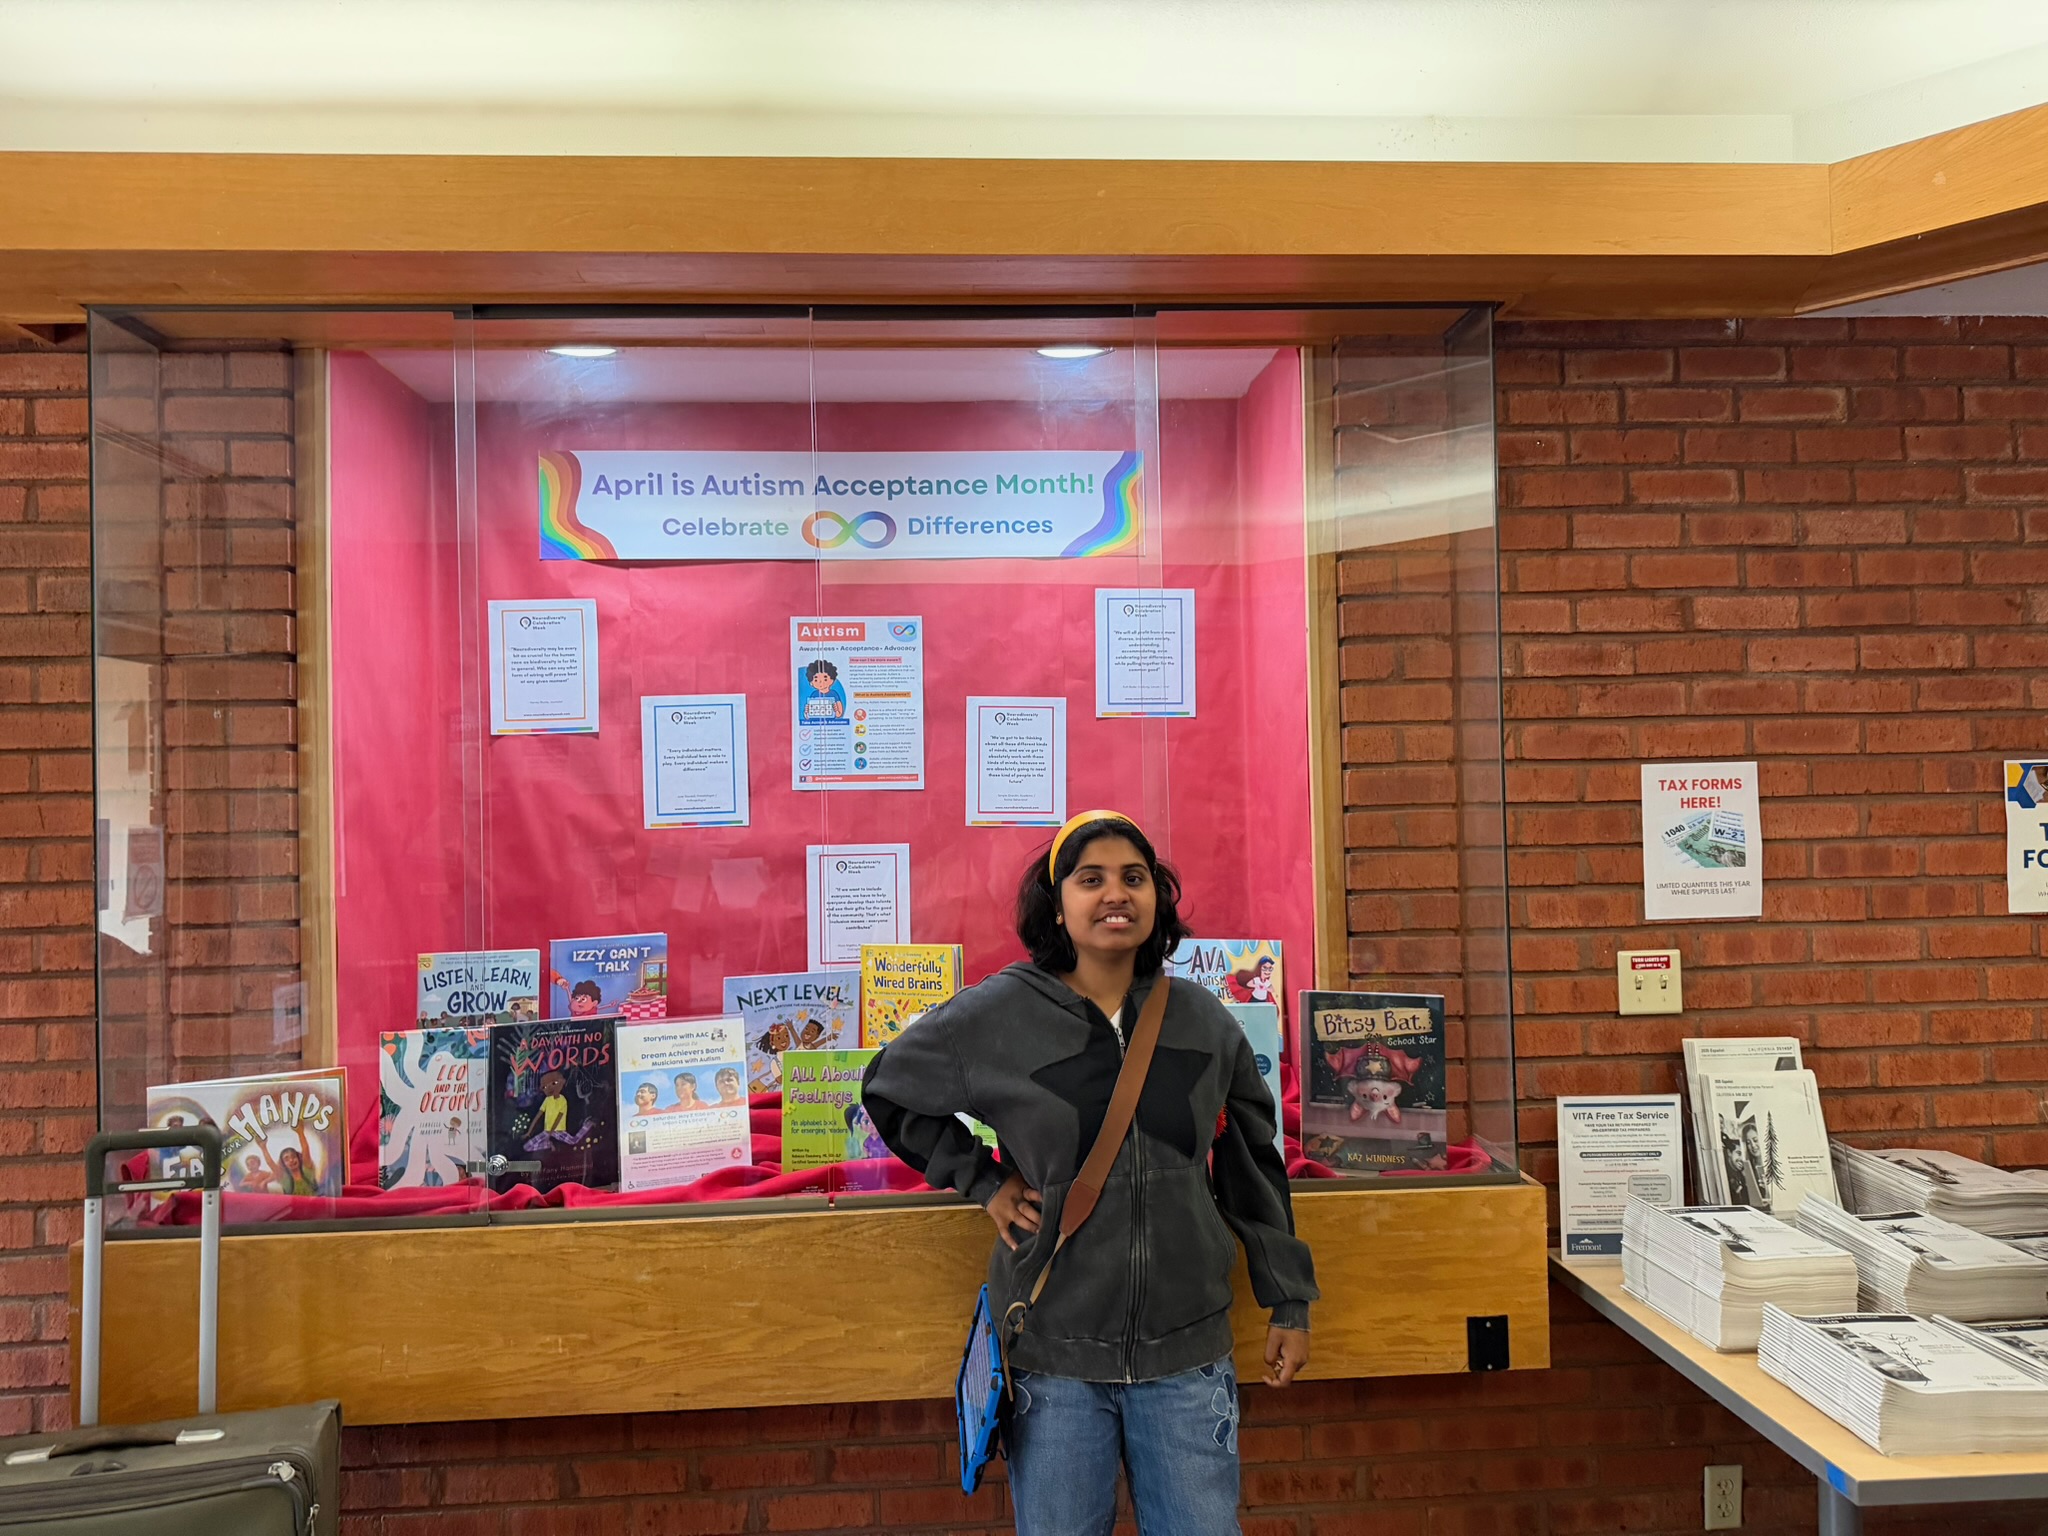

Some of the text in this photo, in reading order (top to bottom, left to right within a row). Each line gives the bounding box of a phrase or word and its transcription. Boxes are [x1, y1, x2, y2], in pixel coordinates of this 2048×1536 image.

[592, 472, 1094, 500] April is Autism Acceptance Month!
[662, 515, 1053, 536] Celebrate Differences
[801, 626, 859, 637] Autism
[1658, 778, 1743, 791] TAX FORMS
[1681, 796, 1721, 809] HERE!
[1665, 824, 1686, 838] 1040
[1714, 828, 1738, 839] W-2
[573, 947, 651, 962] IZZY CAN'T
[1190, 945, 1227, 973] AVA
[595, 960, 630, 973] TALK
[874, 957, 942, 978] Wonderfully
[424, 966, 532, 992] LISTEN, LEARN,
[874, 976, 943, 990] Wired Brains
[447, 991, 507, 1014] GROW
[737, 985, 788, 1011] NEXT
[794, 984, 844, 1002] LEVEL
[1323, 1014, 1376, 1036] Bitsy
[520, 1038, 528, 1051] A
[531, 1036, 551, 1049] DAY
[554, 1034, 580, 1046] WITH
[584, 1032, 602, 1043] NO
[1387, 1036, 1437, 1046] School Star
[510, 1043, 611, 1076] WORDS
[641, 1052, 667, 1060] Dream
[668, 1048, 704, 1057] Achievers
[437, 1064, 468, 1081] LEO
[434, 1083, 467, 1094] AND THE
[420, 1088, 484, 1113] OCTOPUS
[790, 1087, 853, 1109] Feelings
[228, 1092, 333, 1142] HANDS
[1572, 1112, 1594, 1120] VITA
[1596, 1112, 1615, 1120] Free
[1618, 1112, 1634, 1120] Tax
[222, 1139, 241, 1156] YOUR
[1348, 1153, 1405, 1164] KAZ WINDNESS
